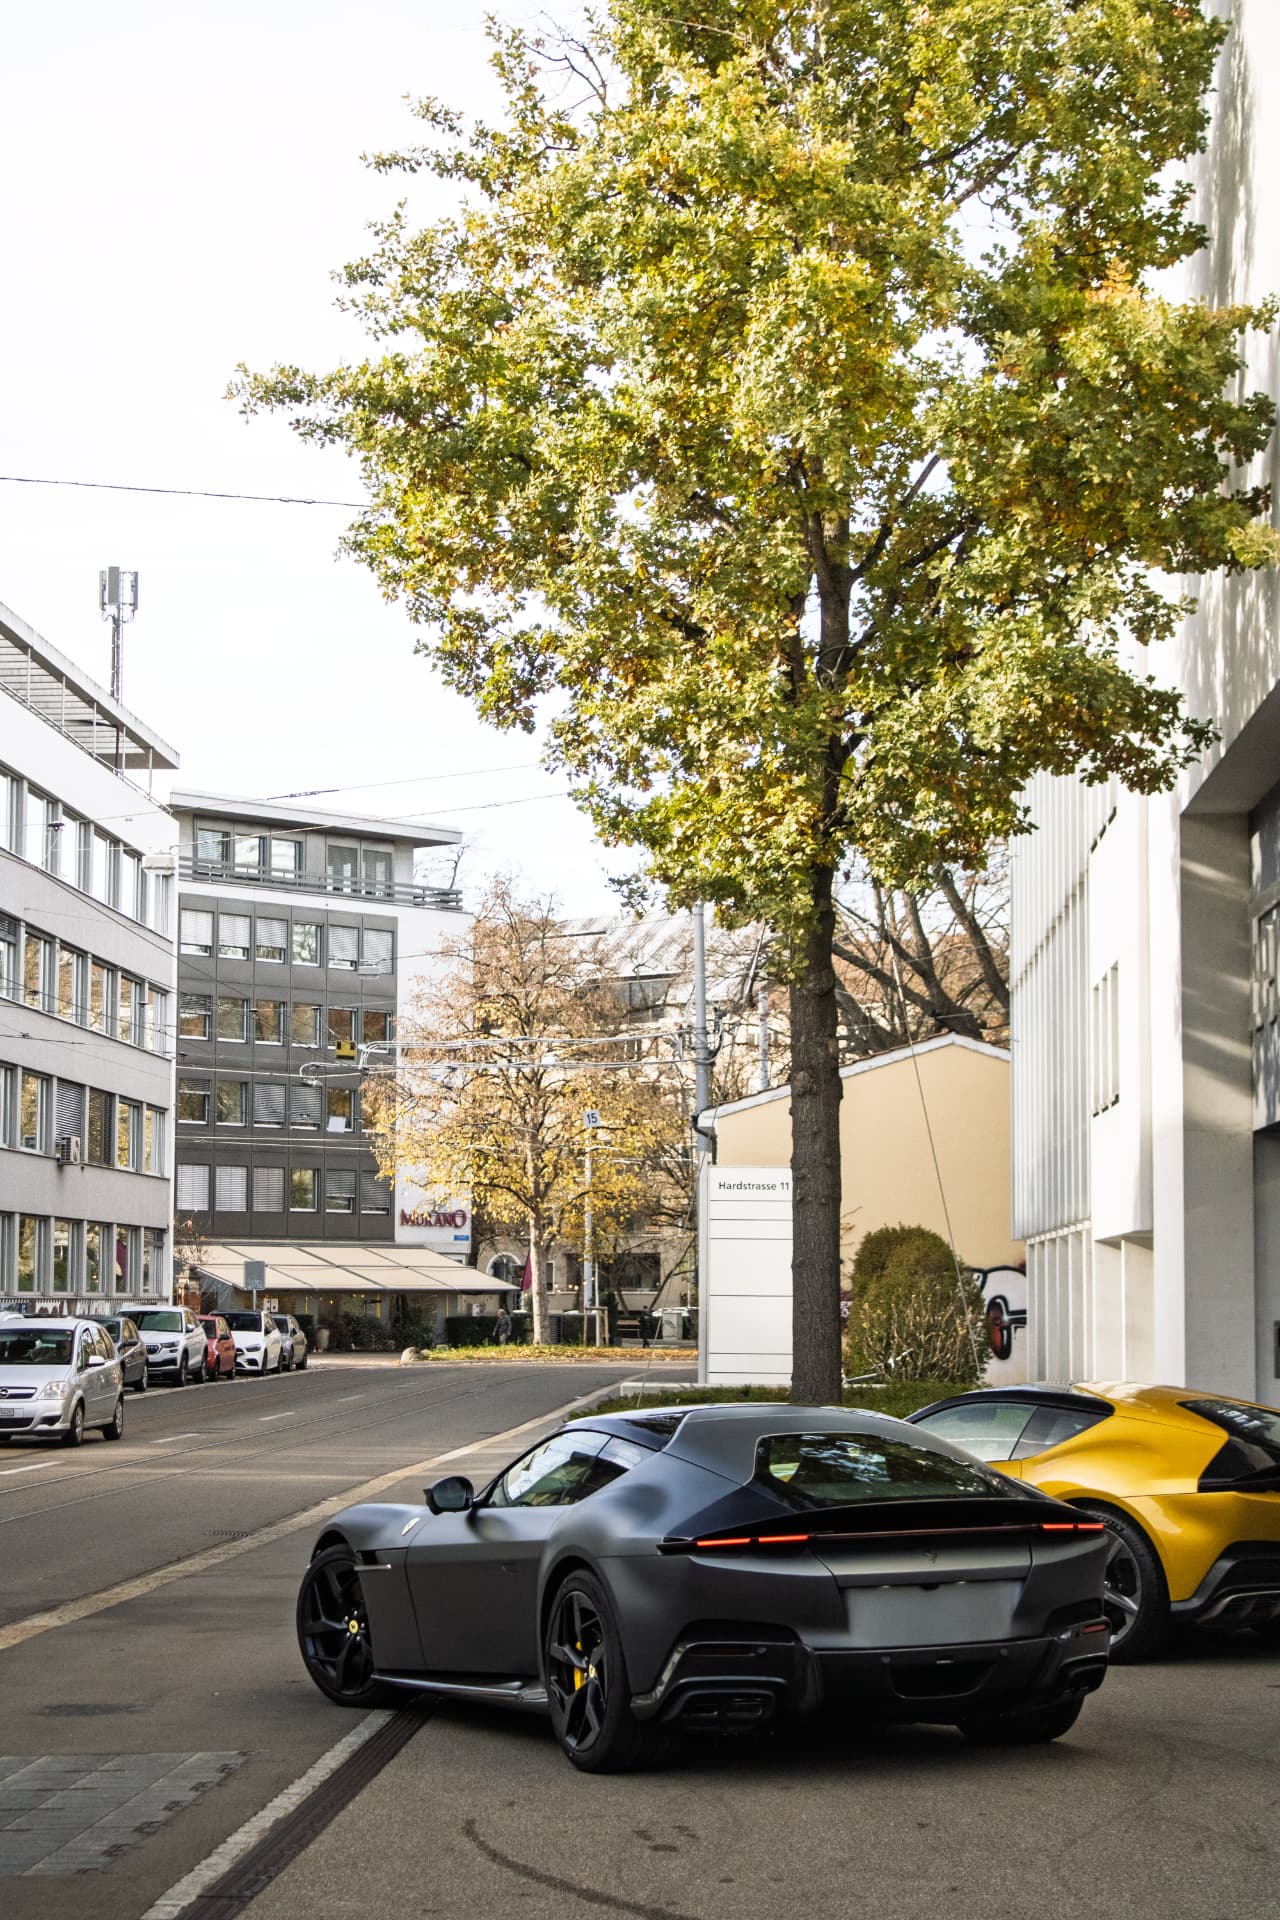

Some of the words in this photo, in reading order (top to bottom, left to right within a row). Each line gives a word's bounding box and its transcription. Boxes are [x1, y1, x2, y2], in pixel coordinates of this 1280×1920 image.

[586, 1112, 598, 1124] 15
[718, 1181, 777, 1191] Hardstrasse
[780, 1182, 790, 1191] 11
